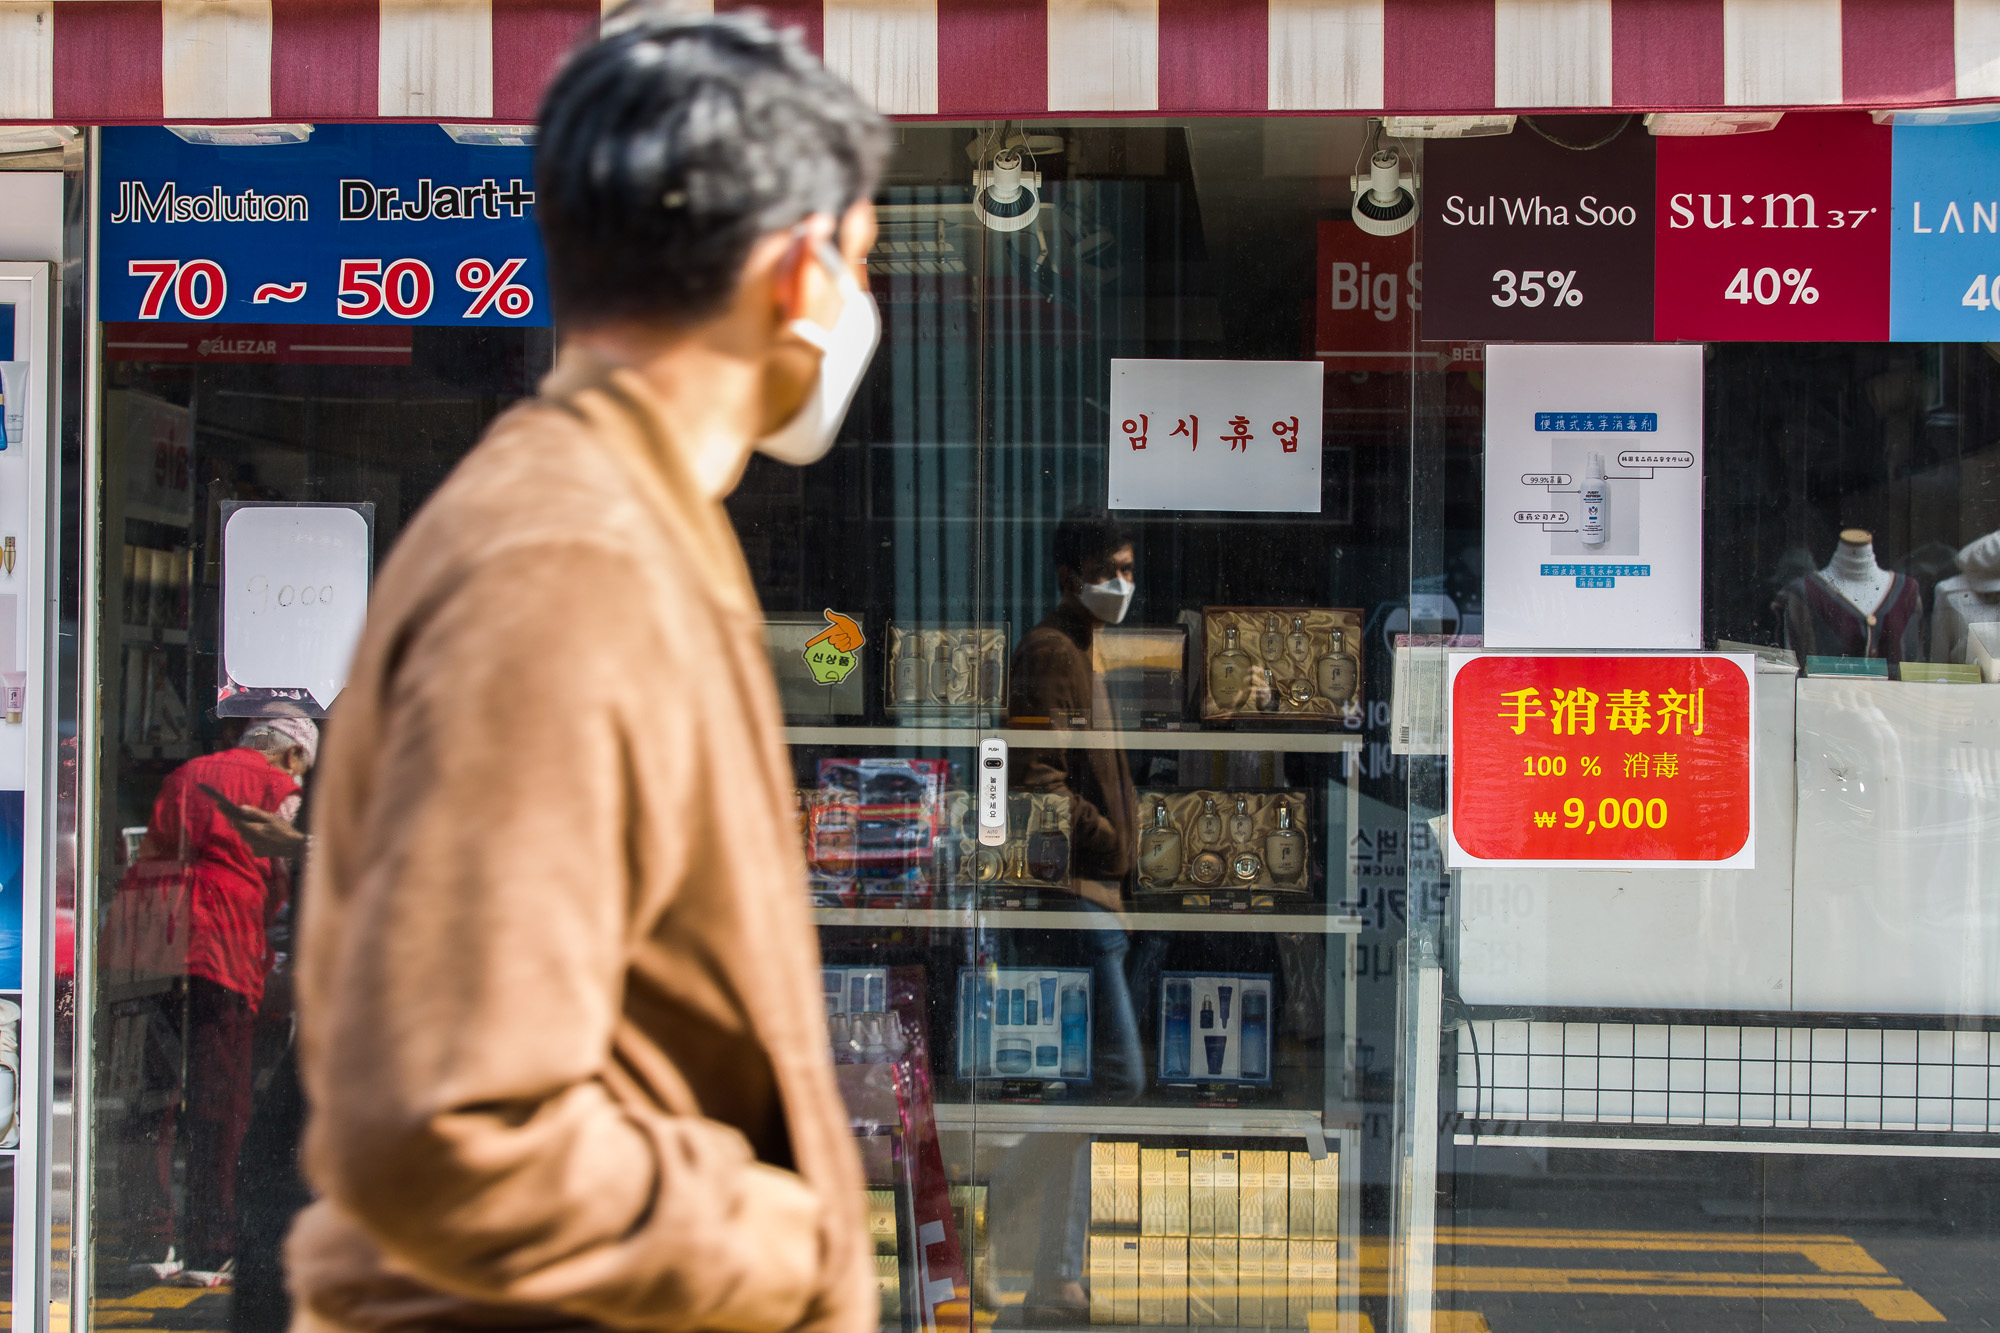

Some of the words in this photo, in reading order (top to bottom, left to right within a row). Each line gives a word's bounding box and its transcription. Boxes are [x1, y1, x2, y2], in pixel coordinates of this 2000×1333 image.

[111, 180, 308, 224] JMsolution
[339, 178, 536, 222] Dr.Jart+
[1669, 192, 1819, 230] su:m
[129, 258, 227, 320] 70
[337, 258, 434, 320] 50
[456, 258, 534, 319] %
[1331, 261, 1399, 322] Big
[1490, 270, 1584, 308] 35%
[1724, 267, 1820, 306] 40%
[1540, 419, 1653, 431] 便携式洗手消毒剂
[812, 652, 850, 667] 신상품
[1497, 686, 1705, 736] 手消毒剂
[1522, 756, 1567, 777] 100
[1580, 756, 1602, 777] %
[1623, 752, 1680, 779] 消毒
